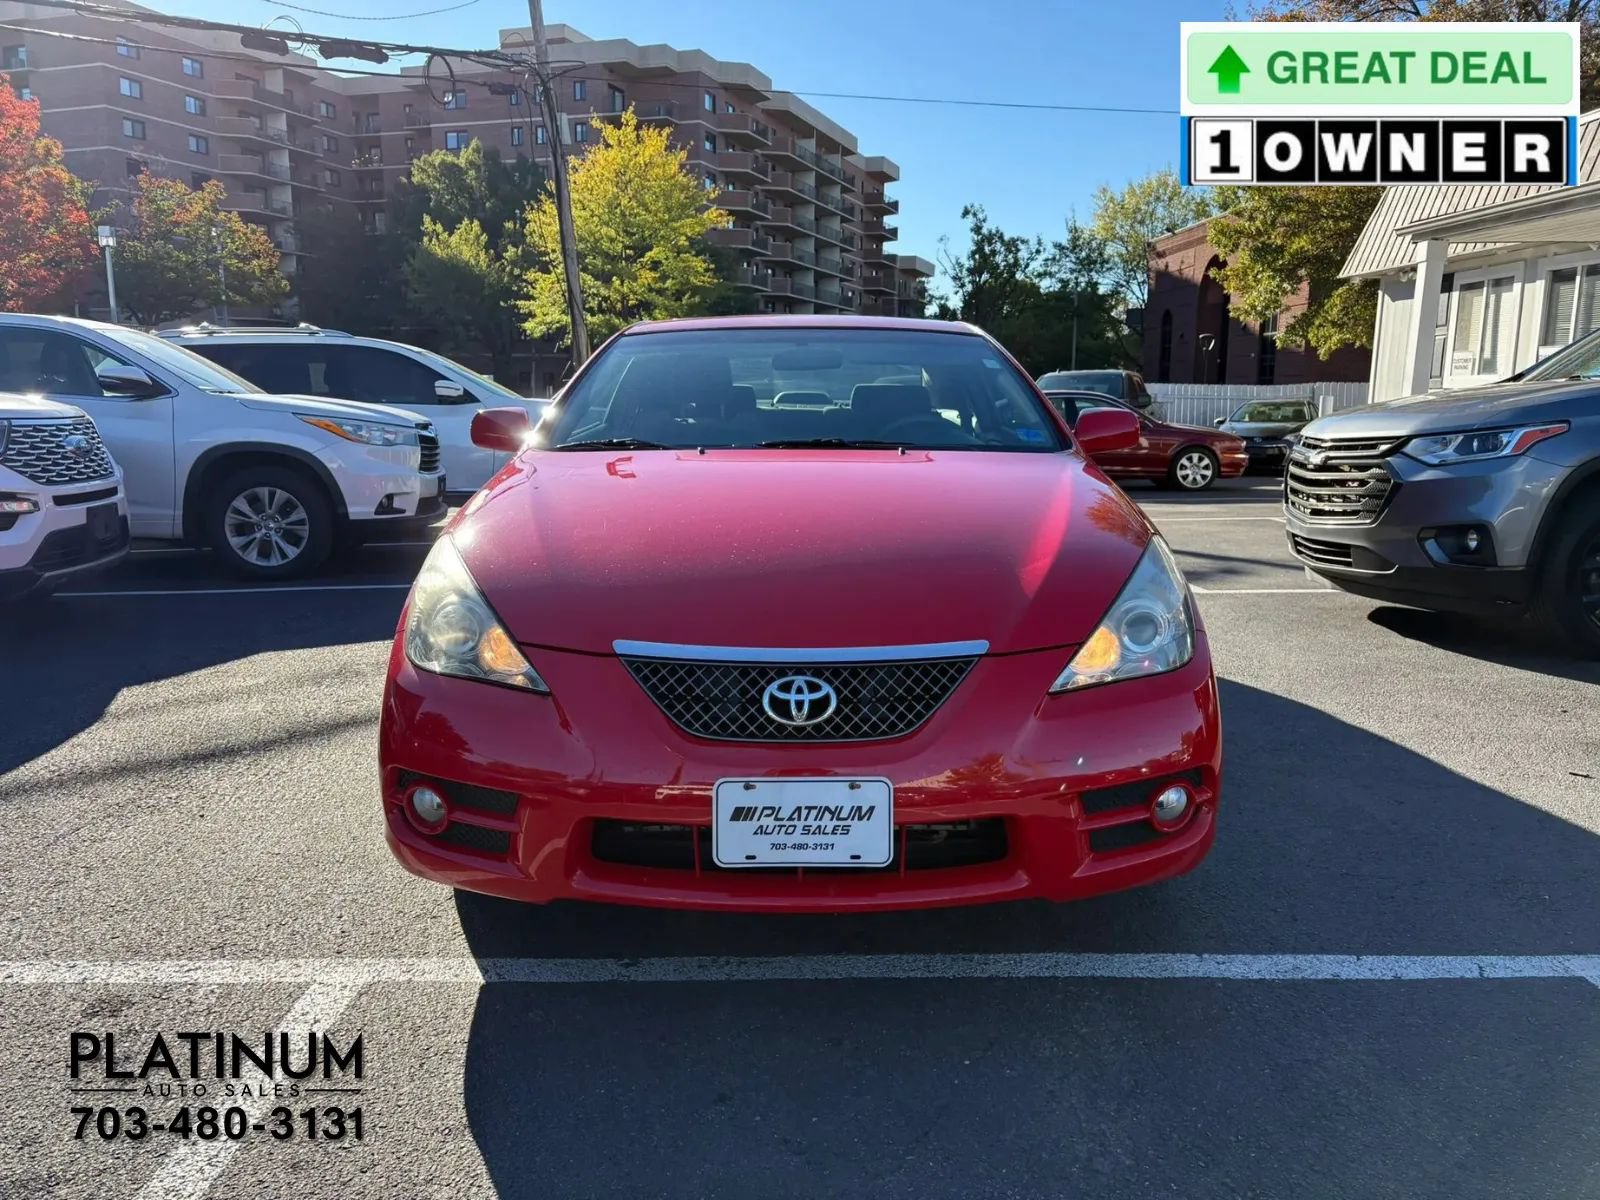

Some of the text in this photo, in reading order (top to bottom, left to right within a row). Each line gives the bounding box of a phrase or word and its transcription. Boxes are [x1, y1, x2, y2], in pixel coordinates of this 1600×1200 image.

[756, 805, 876, 822] PLATINUM
[752, 824, 852, 836] AUTO SALES
[769, 842, 835, 851] 703-480-3131
